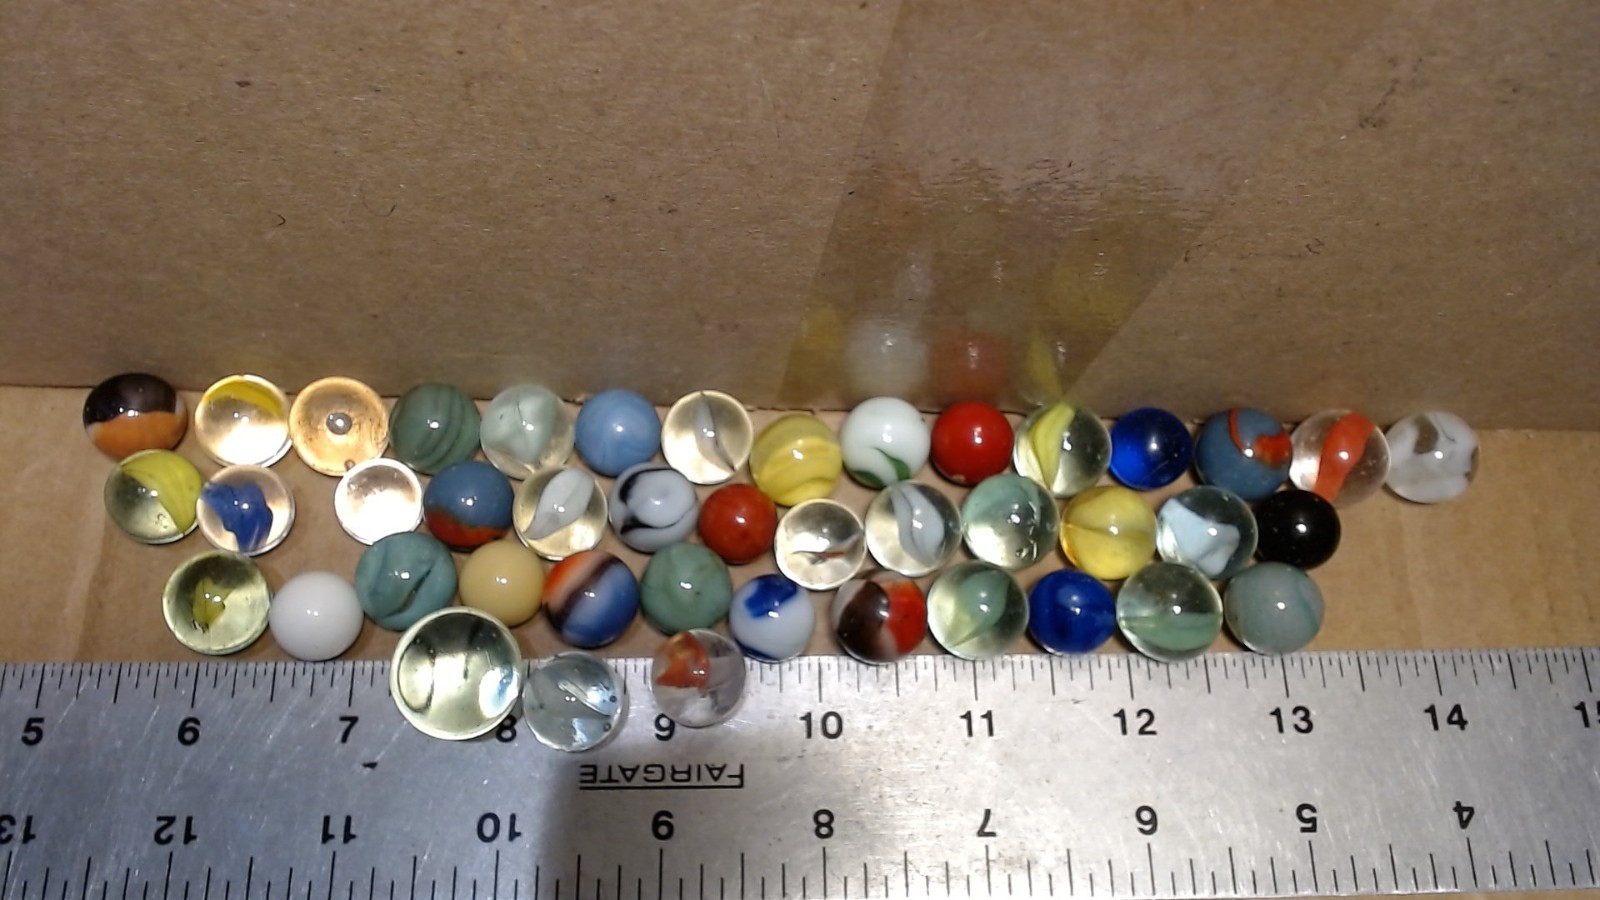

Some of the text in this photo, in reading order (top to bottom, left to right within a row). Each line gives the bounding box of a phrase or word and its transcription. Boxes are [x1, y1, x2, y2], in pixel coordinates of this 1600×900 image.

[654, 713, 676, 741] 9
[800, 711, 843, 739] 10
[960, 710, 993, 737] 11
[1114, 709, 1157, 735] 12
[1270, 706, 1313, 733] 13
[1424, 704, 1468, 731] 14
[1574, 701, 1600, 728] 1
[21, 717, 44, 746] 5
[178, 717, 200, 746] 6
[339, 717, 358, 743] 7
[495, 716, 517, 743] 8
[578, 763, 745, 789] FAIRGATE
[477, 813, 521, 843] 10
[652, 810, 674, 840] 9
[813, 809, 834, 839] 8
[977, 809, 996, 837] 7
[1136, 806, 1157, 835] 6
[1296, 804, 1317, 833] 5
[1453, 801, 1474, 829] 4
[0, 814, 36, 845] 13
[154, 816, 197, 845] 12
[322, 815, 356, 844] 11
